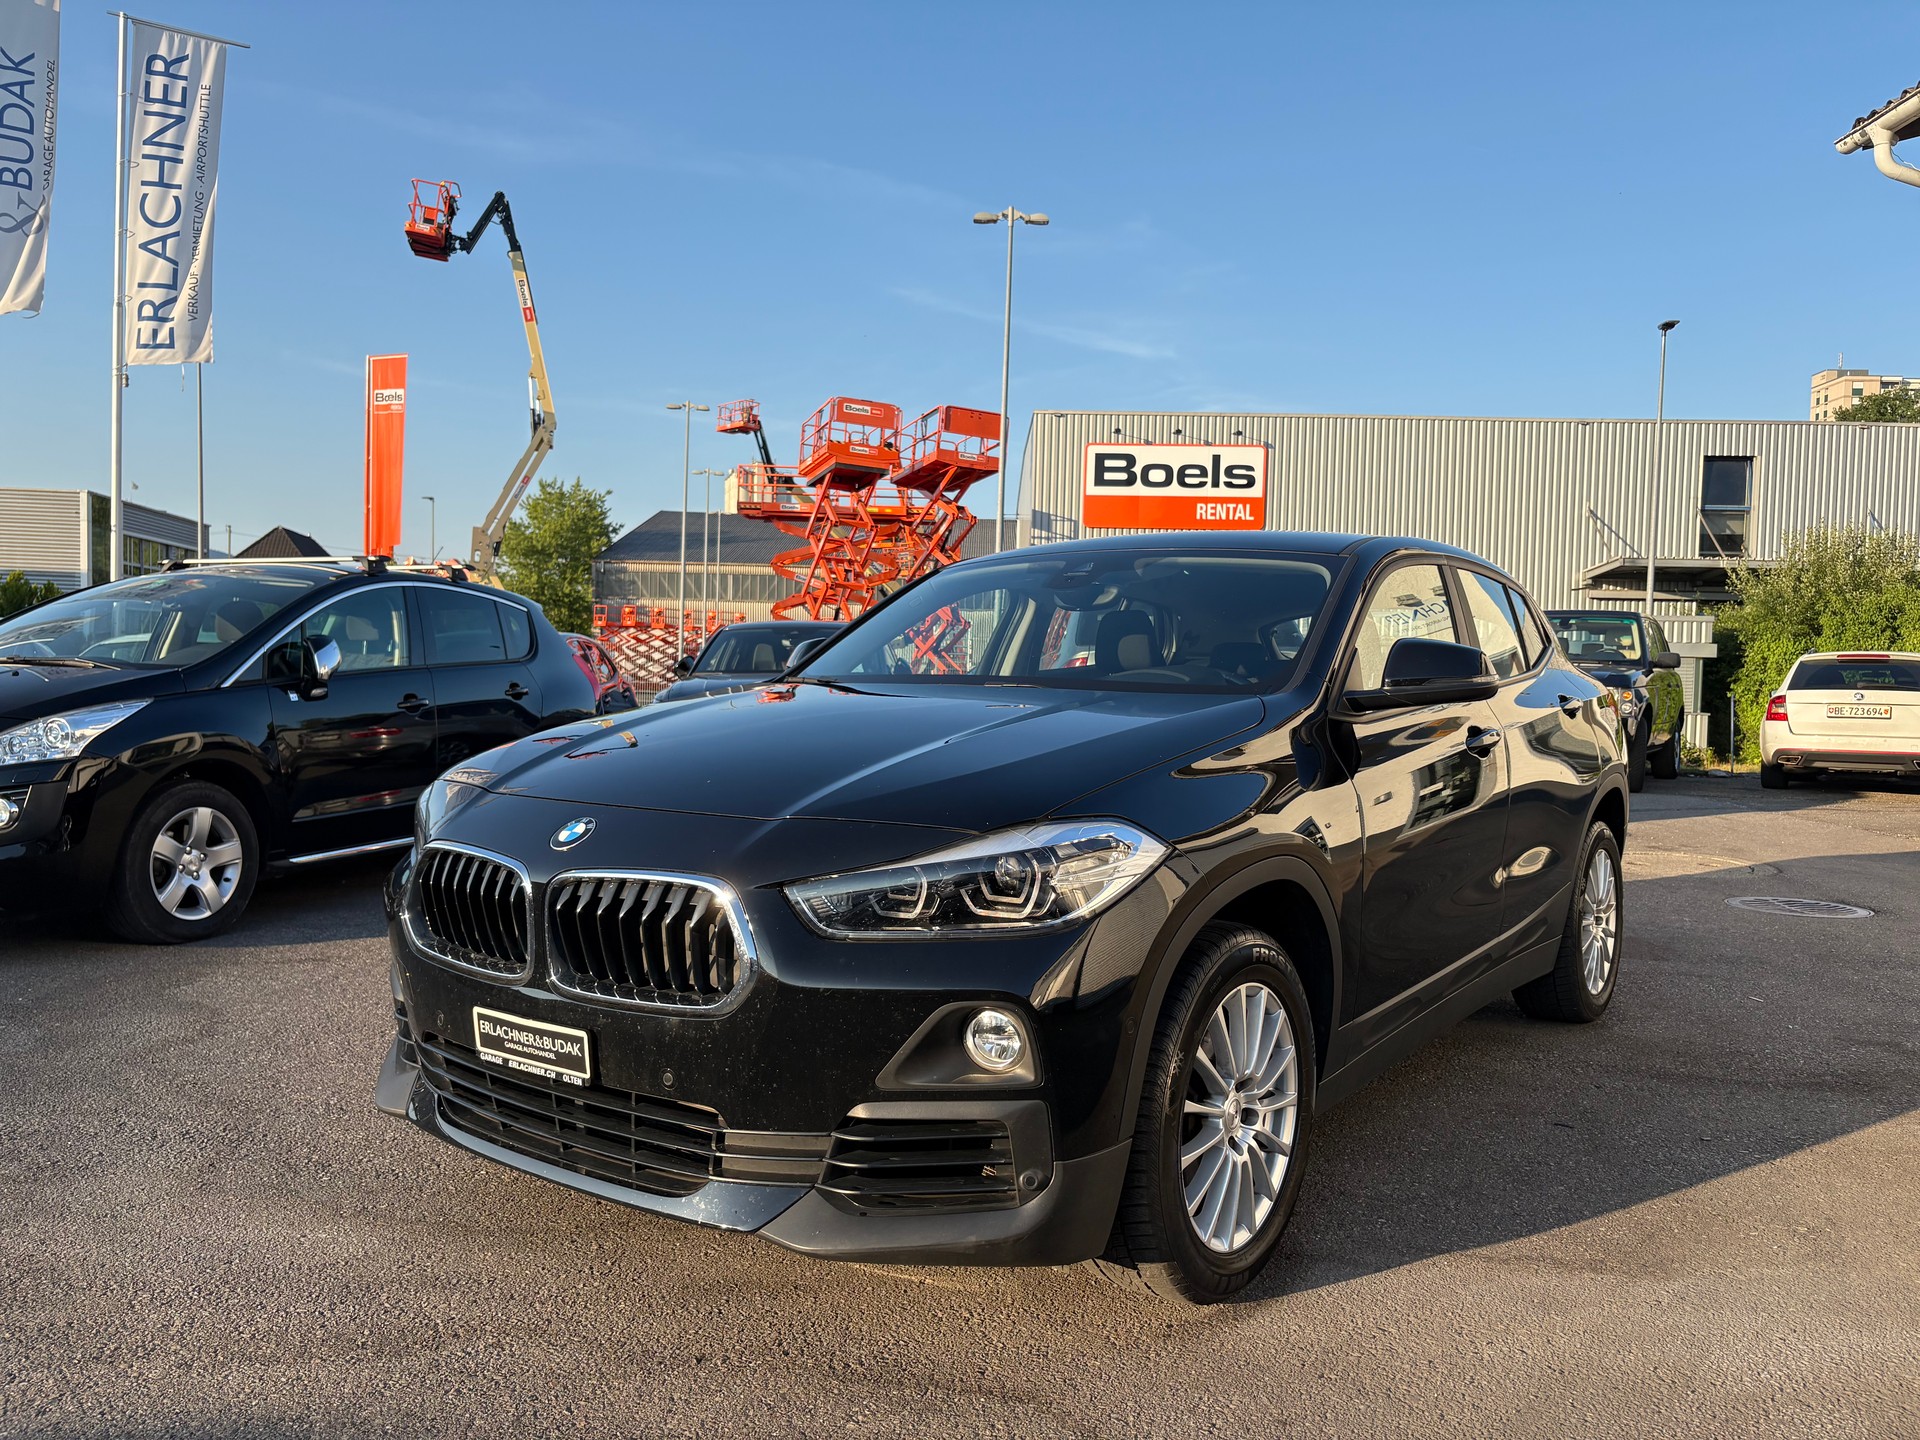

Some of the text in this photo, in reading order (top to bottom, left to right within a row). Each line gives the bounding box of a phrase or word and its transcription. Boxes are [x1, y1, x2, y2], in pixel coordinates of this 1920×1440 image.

[136, 53, 190, 350] ERLACHNER
[192, 191, 205, 264] VERMIETUNG
[188, 270, 200, 322] VERKAUF
[1094, 453, 1256, 489] Boels
[1196, 503, 1255, 521] RENTAL
[480, 1053, 583, 1086] GARAGE ERLACHNER.CH OLTEN
